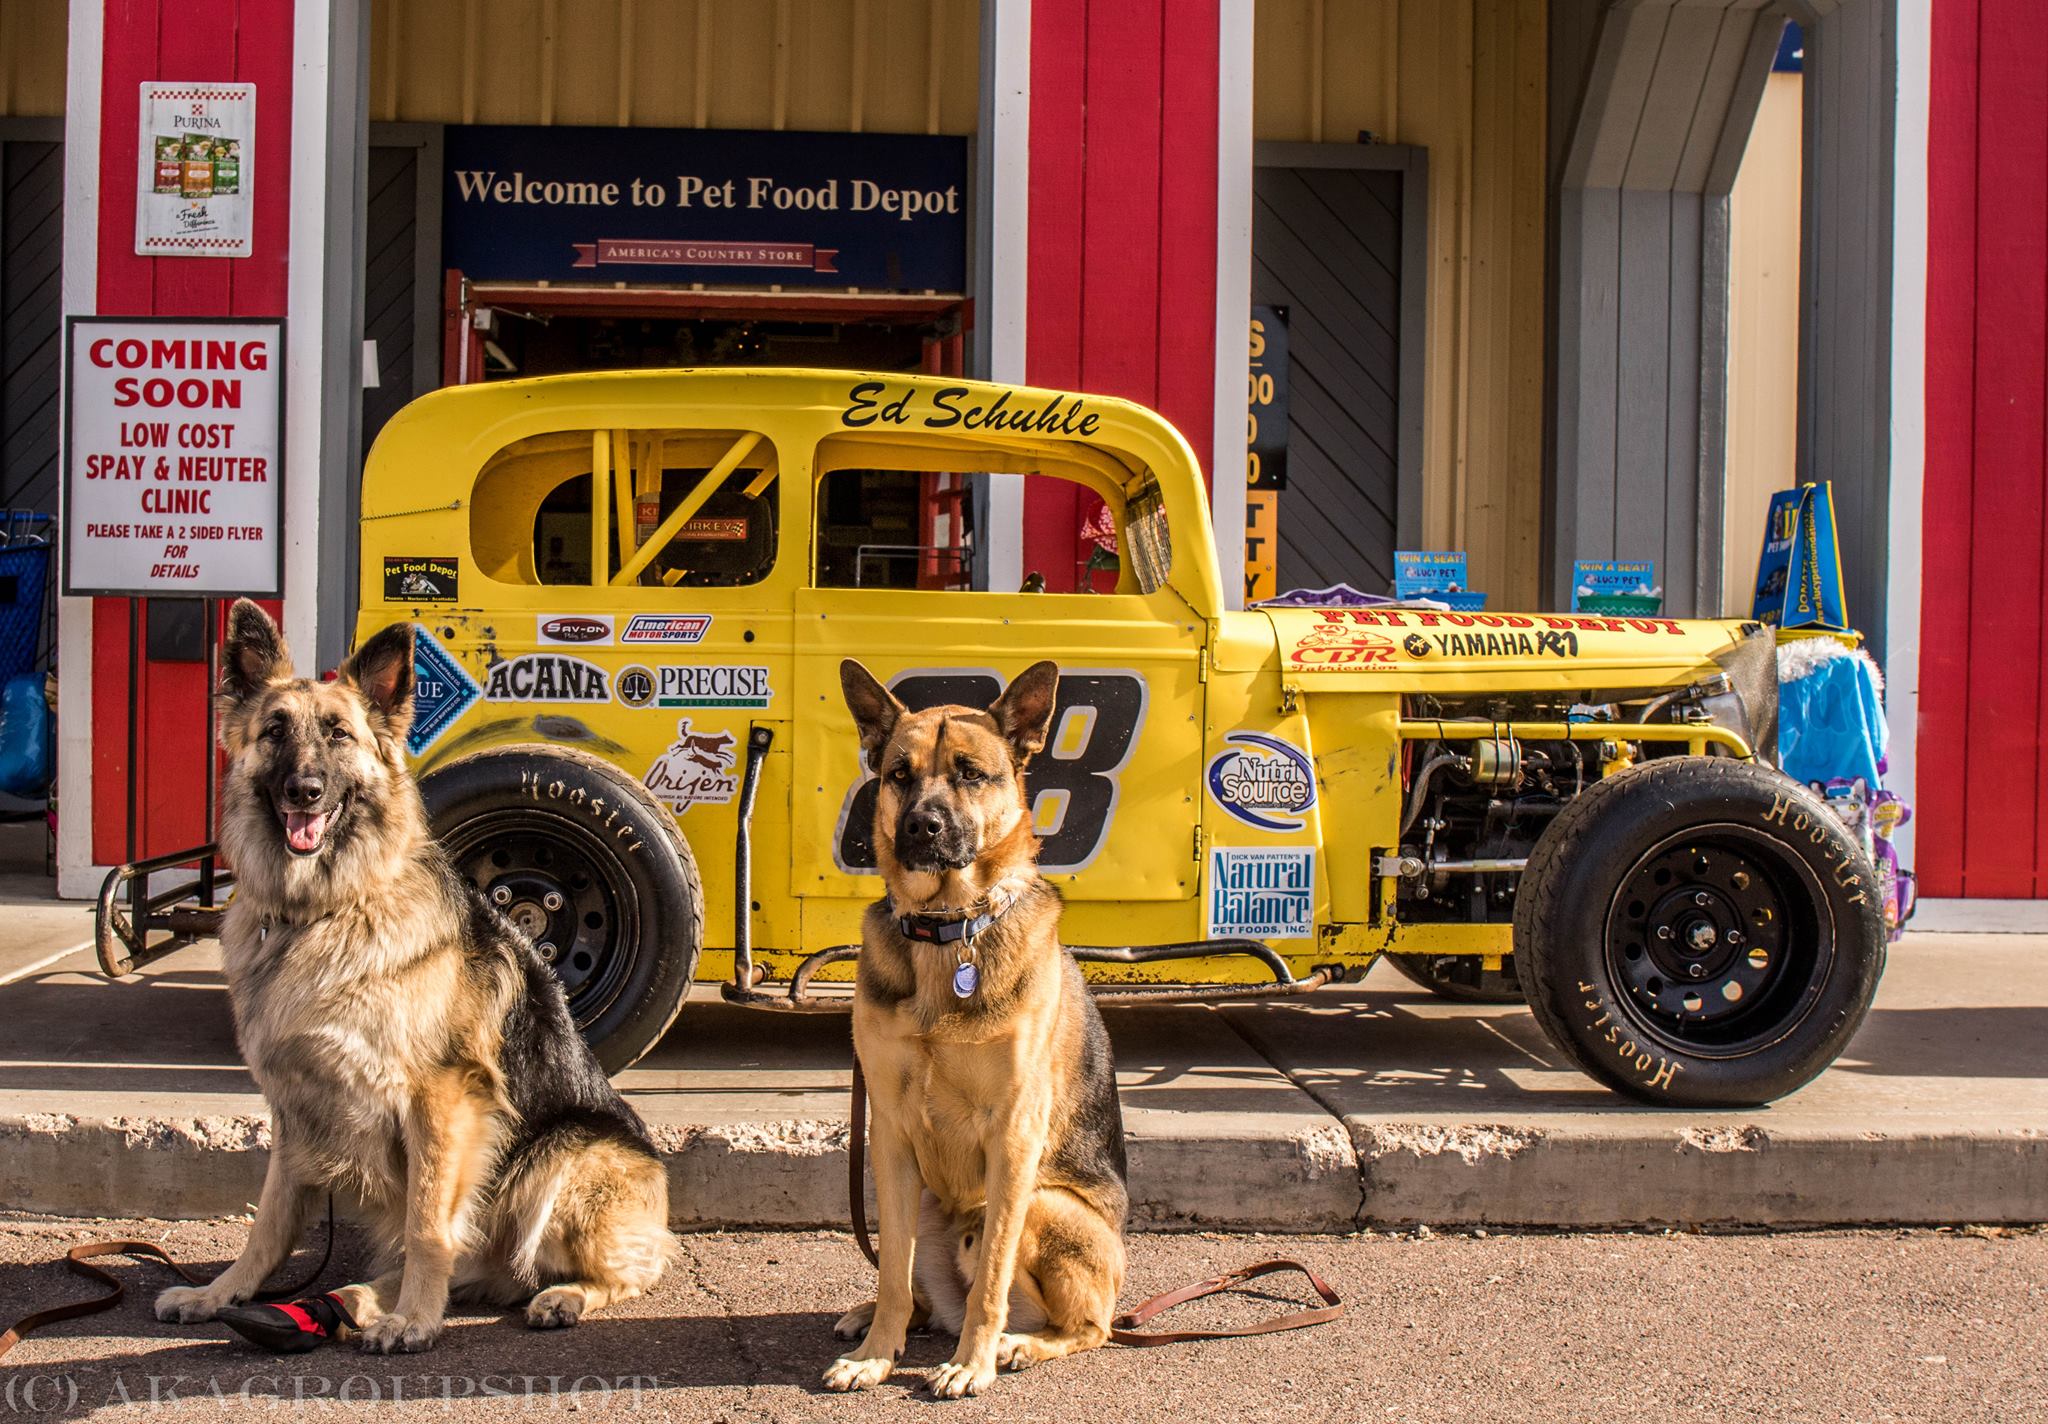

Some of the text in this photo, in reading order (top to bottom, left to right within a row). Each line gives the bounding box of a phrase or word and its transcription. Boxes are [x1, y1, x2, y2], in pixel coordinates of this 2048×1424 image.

[174, 115, 221, 129] PURINA
[454, 170, 959, 222] Welcome to Pet Food Depot
[607, 245, 803, 262] AMERICA'S COUNTRY STORE
[89, 338, 268, 371] COMING
[114, 377, 242, 409] SOON
[841, 382, 1100, 437] Ed Schuhle
[120, 422, 235, 449] LOW COST
[86, 454, 267, 482] SPAY & NEUTER
[141, 488, 211, 514] CLINIC
[87, 523, 263, 541] PLEASE TAKE A 2 SIDED FLYER
[683, 522, 731, 531] IRKEY
[164, 545, 188, 559] FOR
[1399, 554, 1420, 563] WIN
[1424, 555, 1431, 563] A
[150, 564, 200, 578] DETAILS
[385, 563, 457, 577] Pet Food Depot
[1417, 568, 1457, 577] LUCY PET
[1580, 563, 1603, 571] WIN
[1606, 563, 1614, 571] A
[1597, 576, 1641, 584] LUCY PET
[635, 620, 701, 630] American
[1313, 610, 1686, 635] PET FOOD DEPOT
[628, 631, 700, 639] MOTORSPORTS
[1433, 631, 1578, 657] YAMAHA R1
[1291, 647, 1398, 664] CBR
[487, 657, 608, 698] ACANA
[659, 667, 768, 695] PRECISE
[417, 682, 444, 697] UE
[1239, 757, 1298, 782] Nutri
[645, 761, 734, 812] Orijen
[1221, 774, 1308, 804] Source
[1215, 852, 1311, 889] Natural
[1213, 888, 1310, 925] Balance
[1213, 926, 1233, 935] PET
[1285, 925, 1309, 934] INC.
